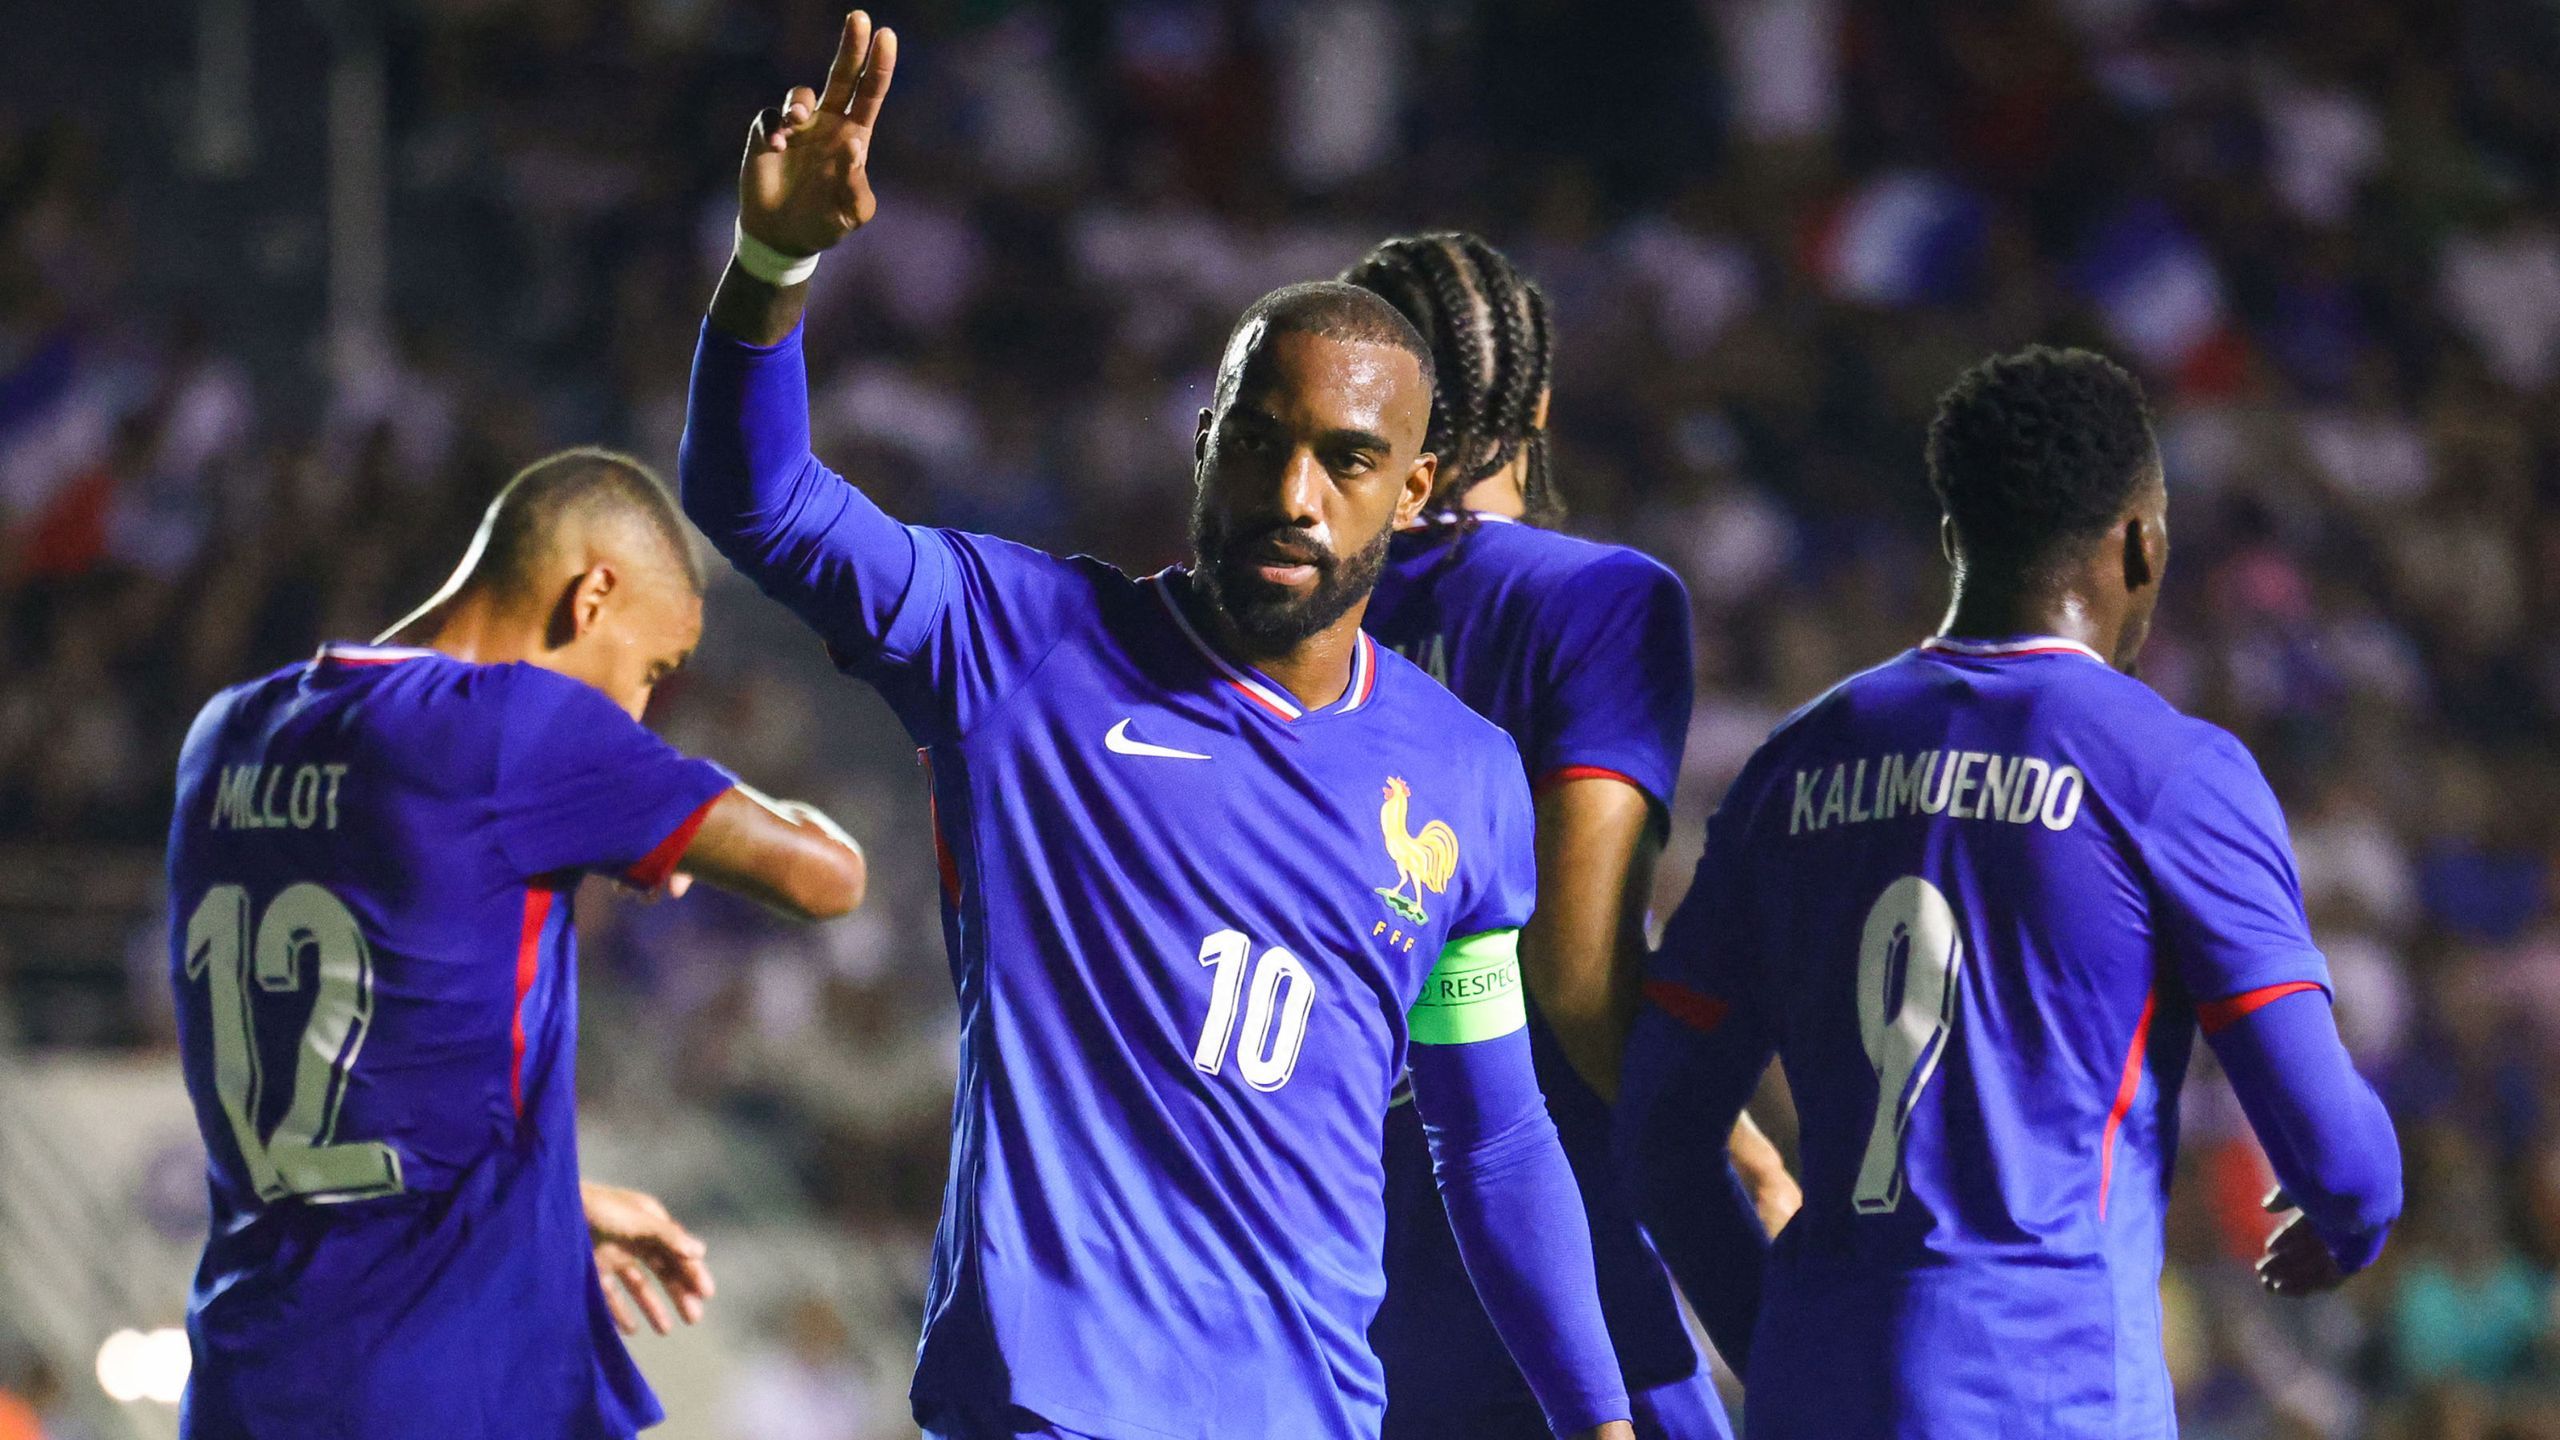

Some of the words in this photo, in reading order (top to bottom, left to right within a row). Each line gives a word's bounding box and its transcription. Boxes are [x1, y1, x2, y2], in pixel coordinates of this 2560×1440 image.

[210, 764, 347, 830] MILLOT
[1790, 750, 2084, 836] KALIMUENDO
[1193, 928, 1316, 1092] 10
[1441, 961, 1516, 999] RESPEC
[186, 882, 404, 1204] 12
[1852, 875, 1962, 1214] 9
